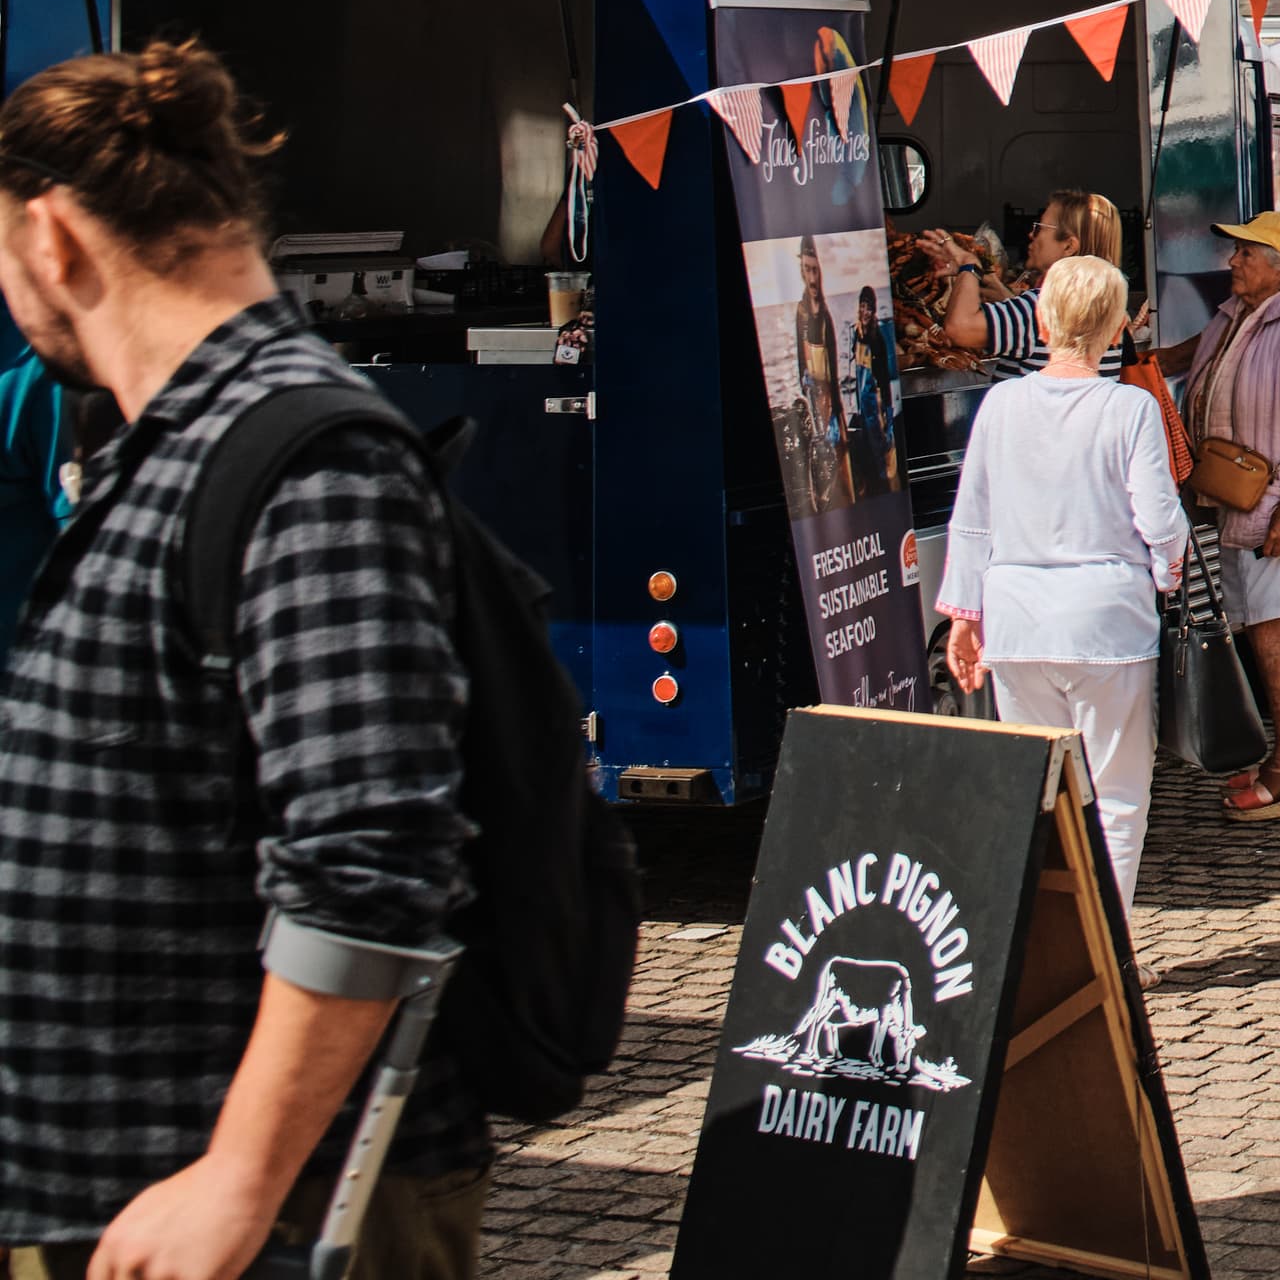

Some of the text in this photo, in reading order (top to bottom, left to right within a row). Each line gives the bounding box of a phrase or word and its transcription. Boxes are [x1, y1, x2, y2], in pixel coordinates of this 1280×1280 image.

[812, 543, 853, 580] FRESH
[851, 532, 886, 567] LOCAL
[819, 569, 890, 620] SUSTAINABLE
[825, 615, 877, 660] SEAFOOD
[764, 852, 975, 1003] BLANC PIGNON
[757, 1083, 926, 1161] DAIRY FARM
